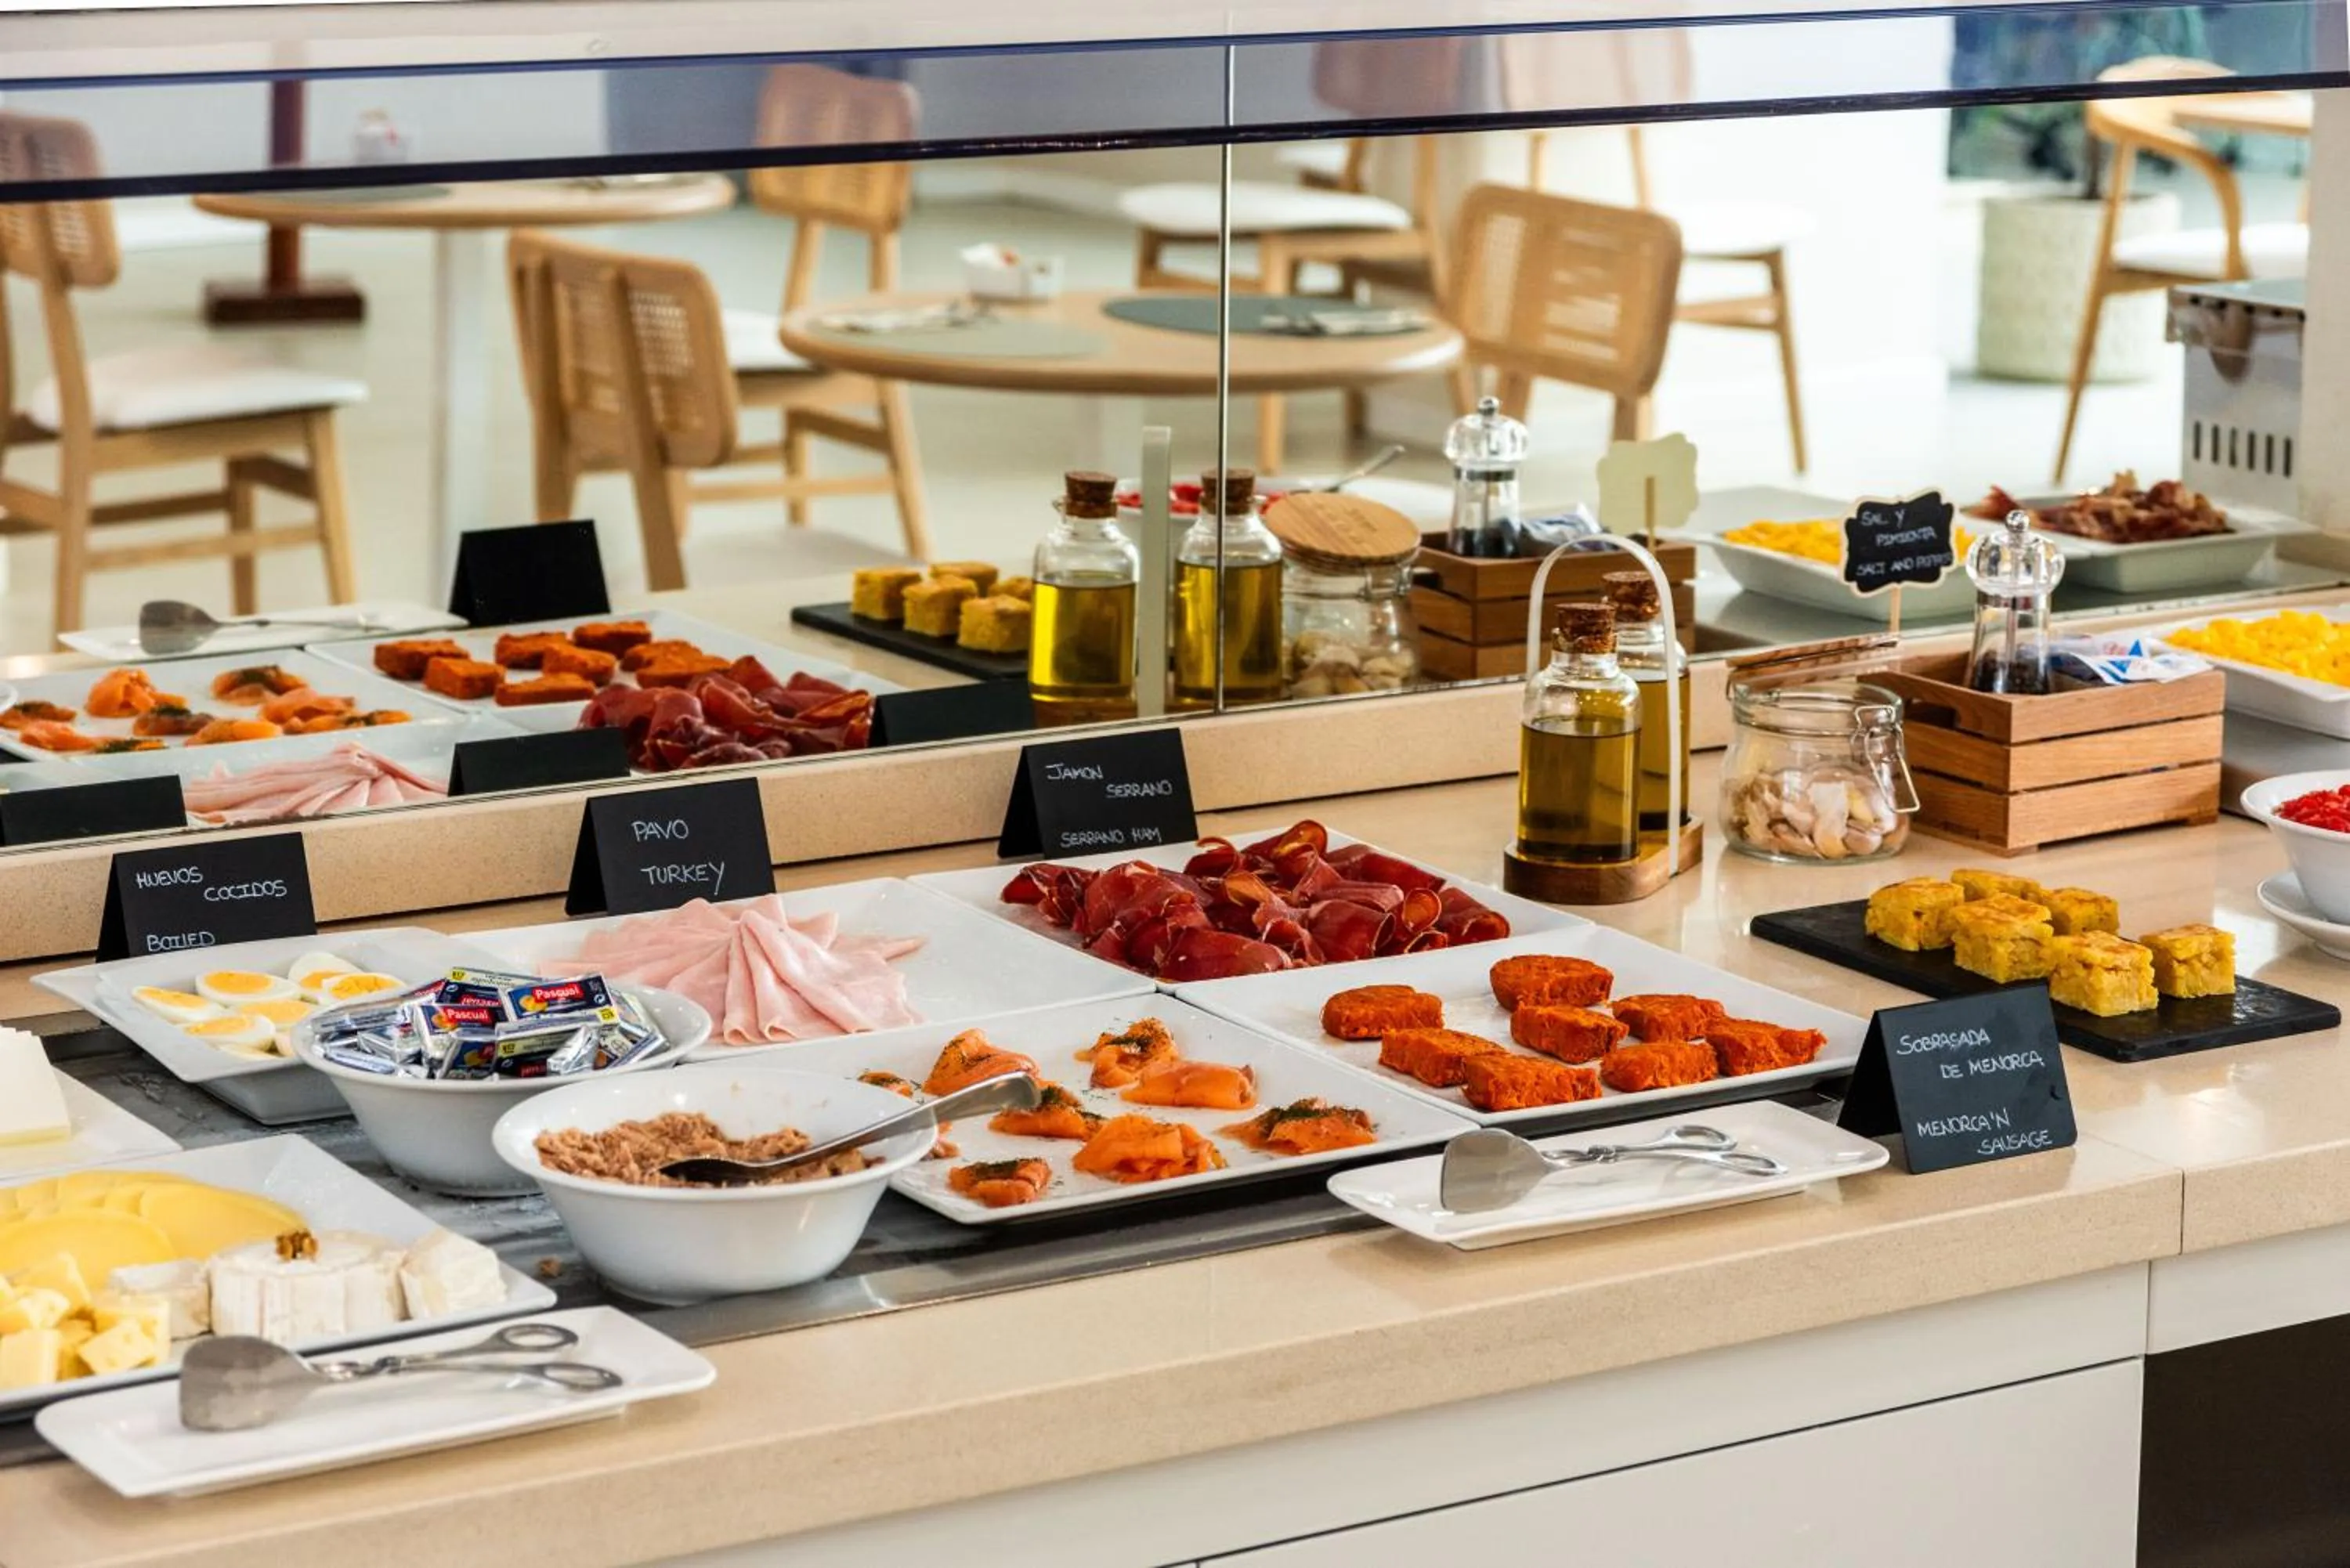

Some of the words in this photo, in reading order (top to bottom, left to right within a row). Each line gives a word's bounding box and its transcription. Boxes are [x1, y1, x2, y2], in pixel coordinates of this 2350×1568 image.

[1895, 509, 1906, 529] Y
[1890, 557, 1914, 572] AND
[1045, 762, 1104, 780] JAMON
[1105, 779, 1173, 799] SERRANO
[631, 818, 689, 842] PAVO
[1060, 829, 1125, 848] SERRANO
[1132, 826, 1161, 844] HAM
[136, 865, 204, 889] HUEVOS
[640, 861, 725, 896] TURKEY
[203, 880, 287, 901] COCIDOS
[146, 931, 215, 952] BOILED
[535, 985, 579, 999] Pascual
[446, 1008, 489, 1019] Pascual
[1940, 1063, 1963, 1078] DE
[1969, 1050, 2045, 1075] MENORCA
[1977, 1130, 2053, 1155] SAUSAGE
